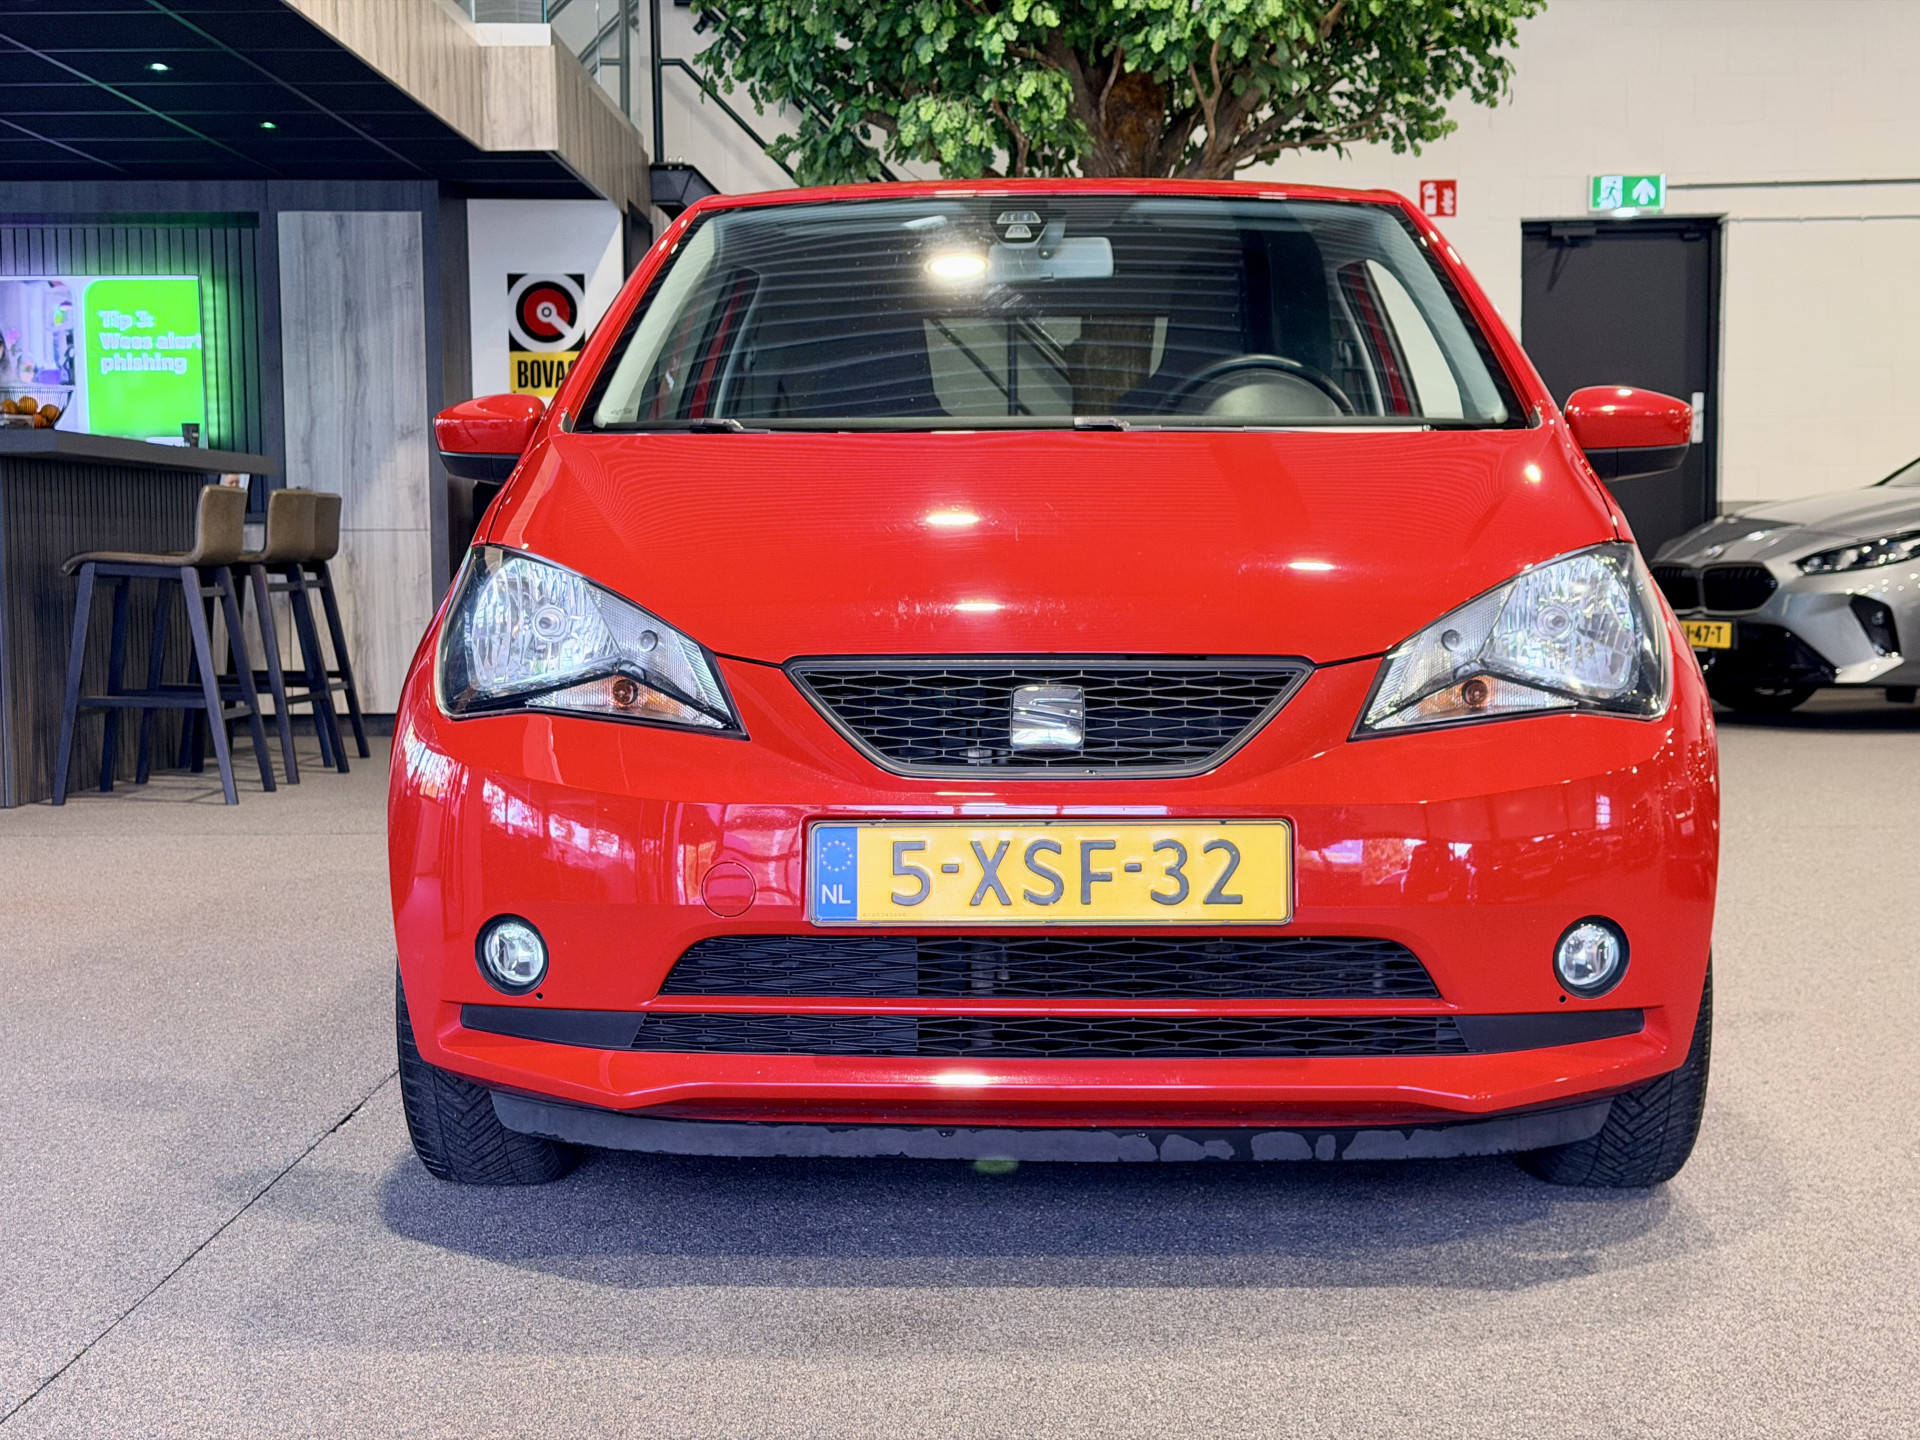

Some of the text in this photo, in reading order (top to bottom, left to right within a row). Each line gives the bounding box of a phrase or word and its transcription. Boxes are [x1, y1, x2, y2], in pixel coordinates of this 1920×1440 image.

[100, 310, 154, 330] Tip 3:
[100, 333, 152, 349] Wees
[101, 353, 187, 374] phishing
[891, 839, 1243, 906] 5-XSF-32
[821, 884, 851, 904] NL
